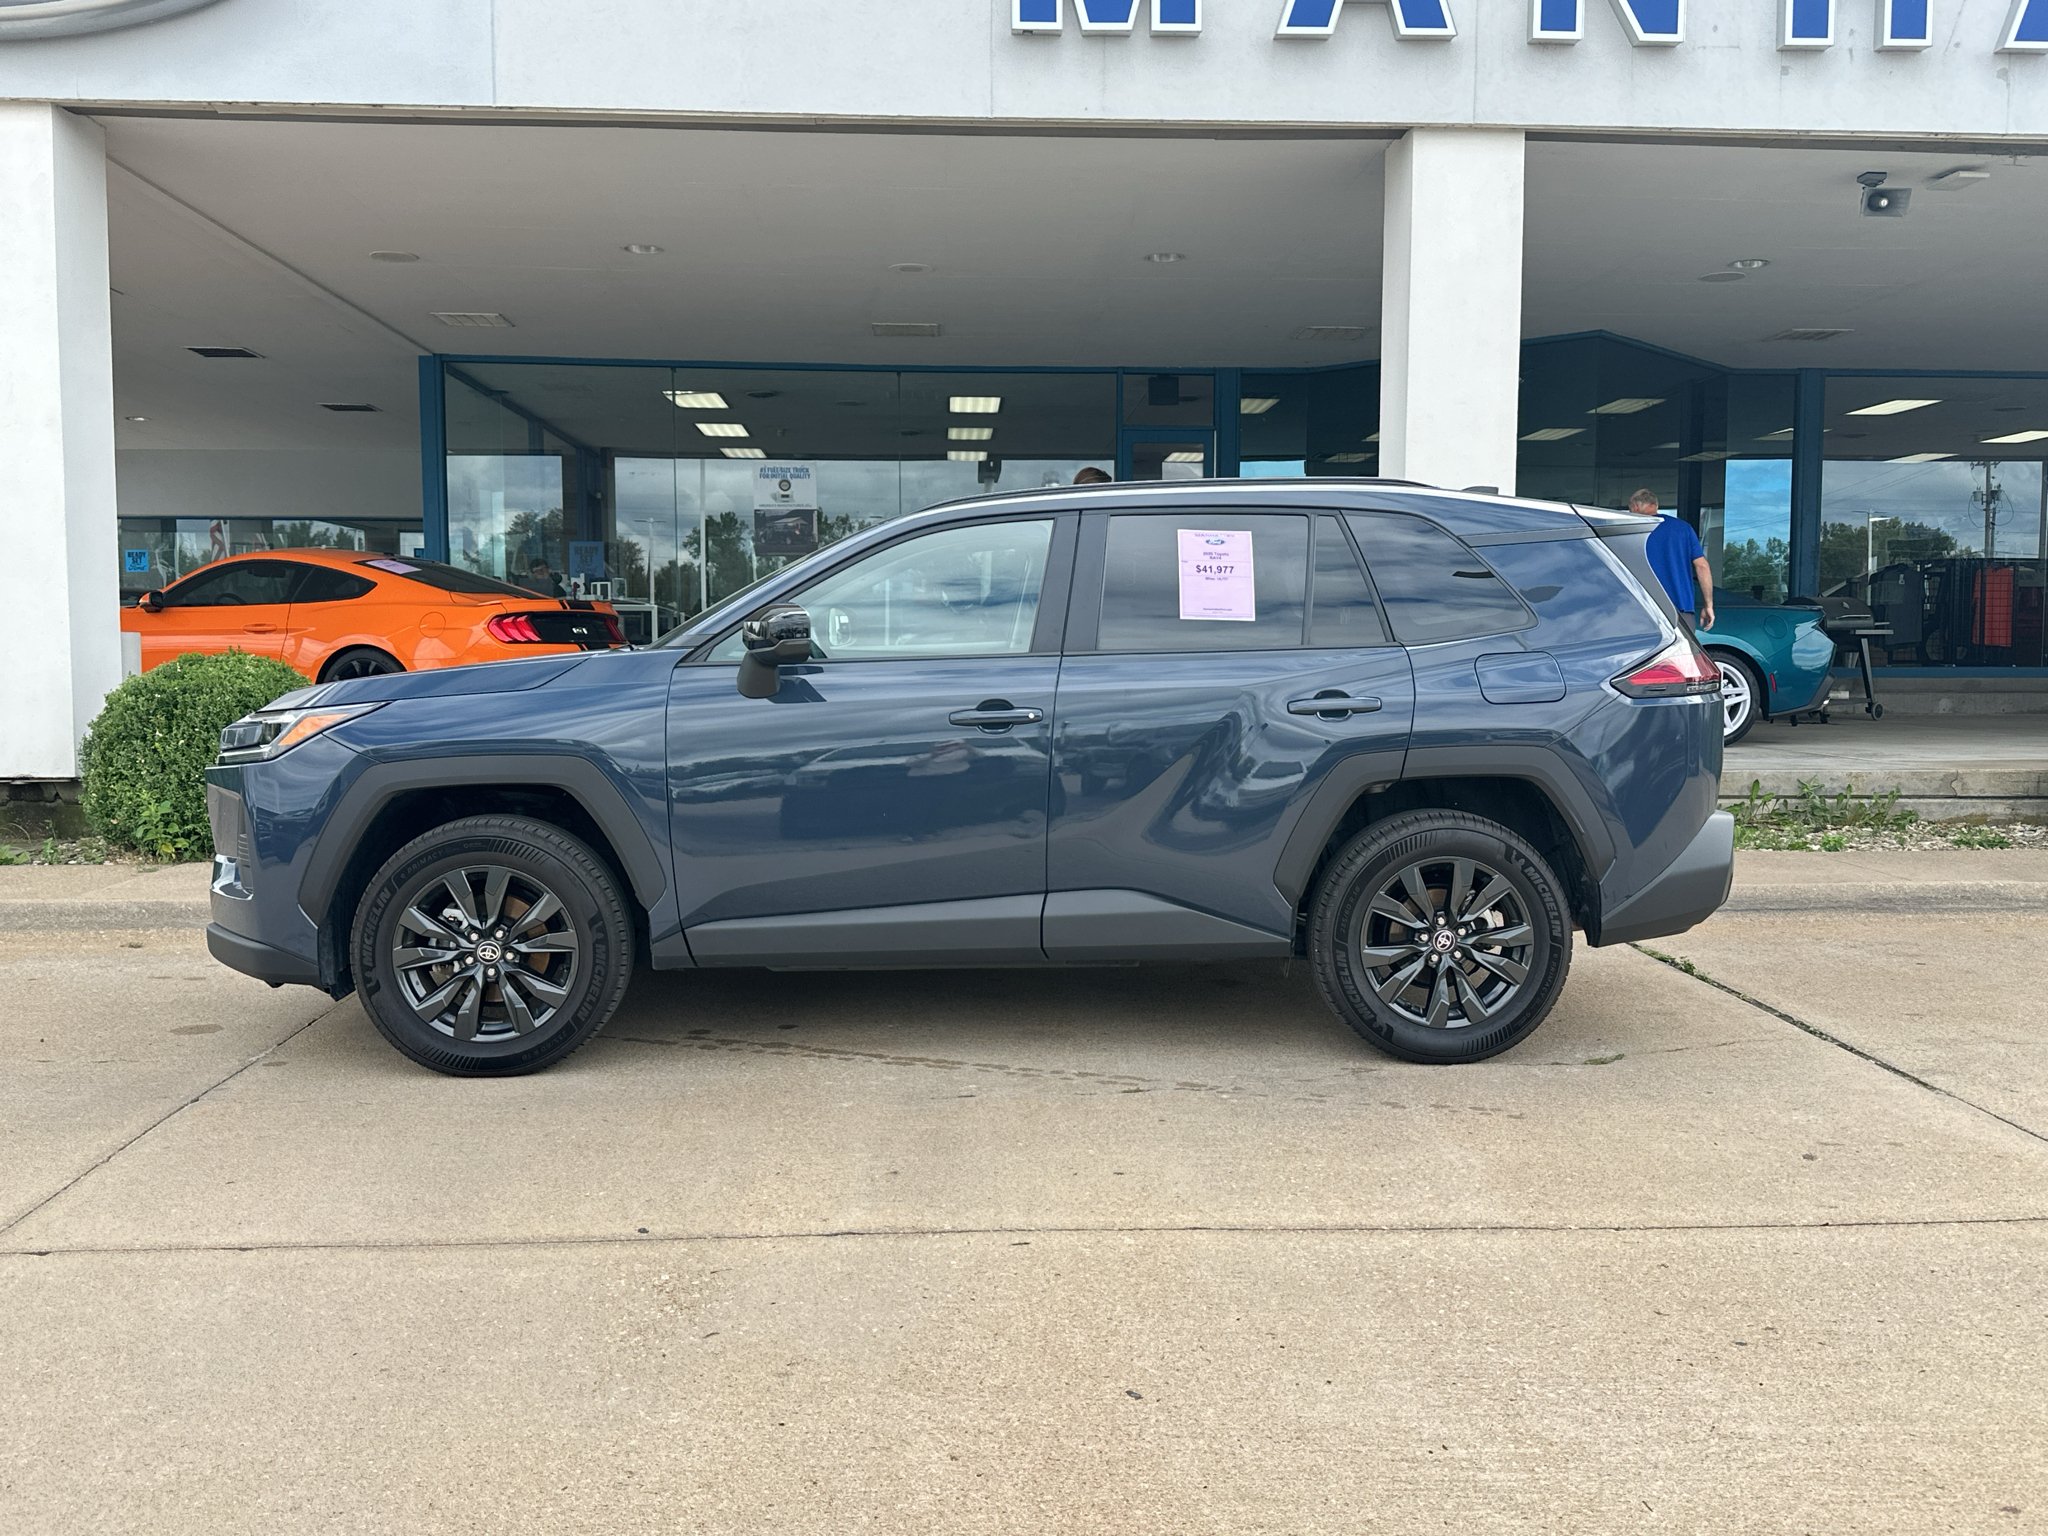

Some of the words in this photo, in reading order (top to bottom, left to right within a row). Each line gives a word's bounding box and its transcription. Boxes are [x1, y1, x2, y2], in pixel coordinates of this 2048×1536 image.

[1195, 564, 1234, 575] $41,977
[362, 886, 392, 966] MICHELIN
[1524, 866, 1562, 937] MICHELIN
[576, 942, 607, 1022] MICHELIN
[1335, 949, 1375, 1020] MICHELIN
